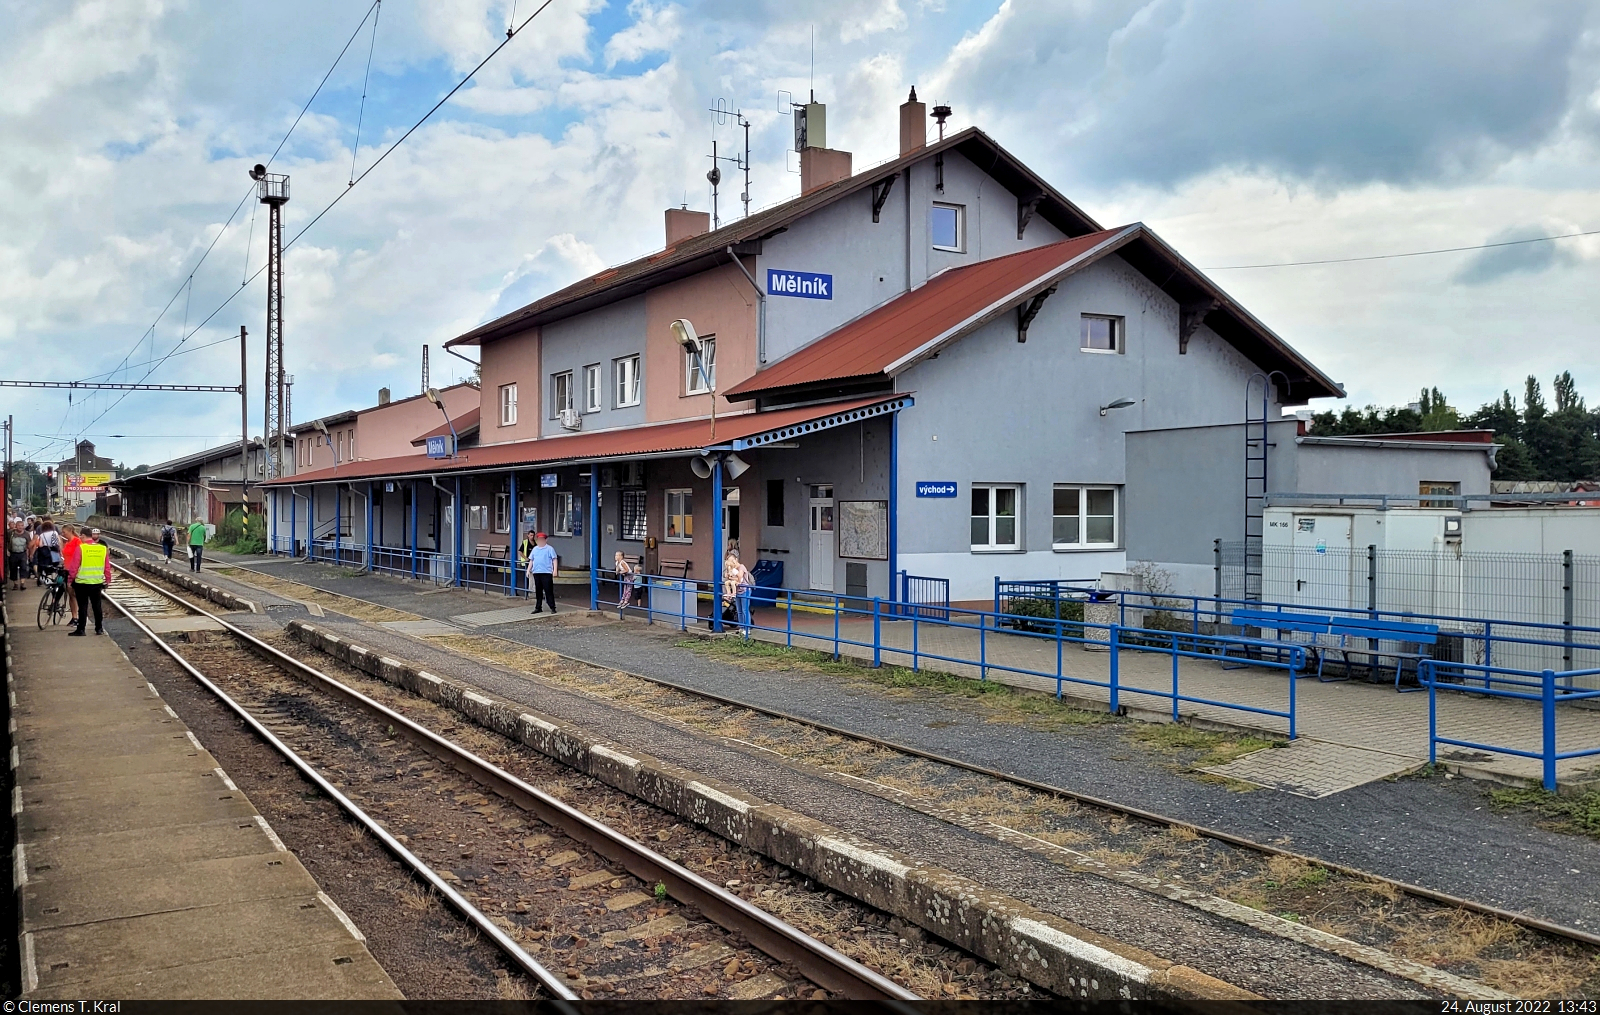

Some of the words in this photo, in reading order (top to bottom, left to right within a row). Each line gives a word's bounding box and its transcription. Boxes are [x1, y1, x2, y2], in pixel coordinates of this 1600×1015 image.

[772, 274, 828, 296] Mělník
[428, 439, 444, 455] Mělník
[919, 485, 946, 496] východ
